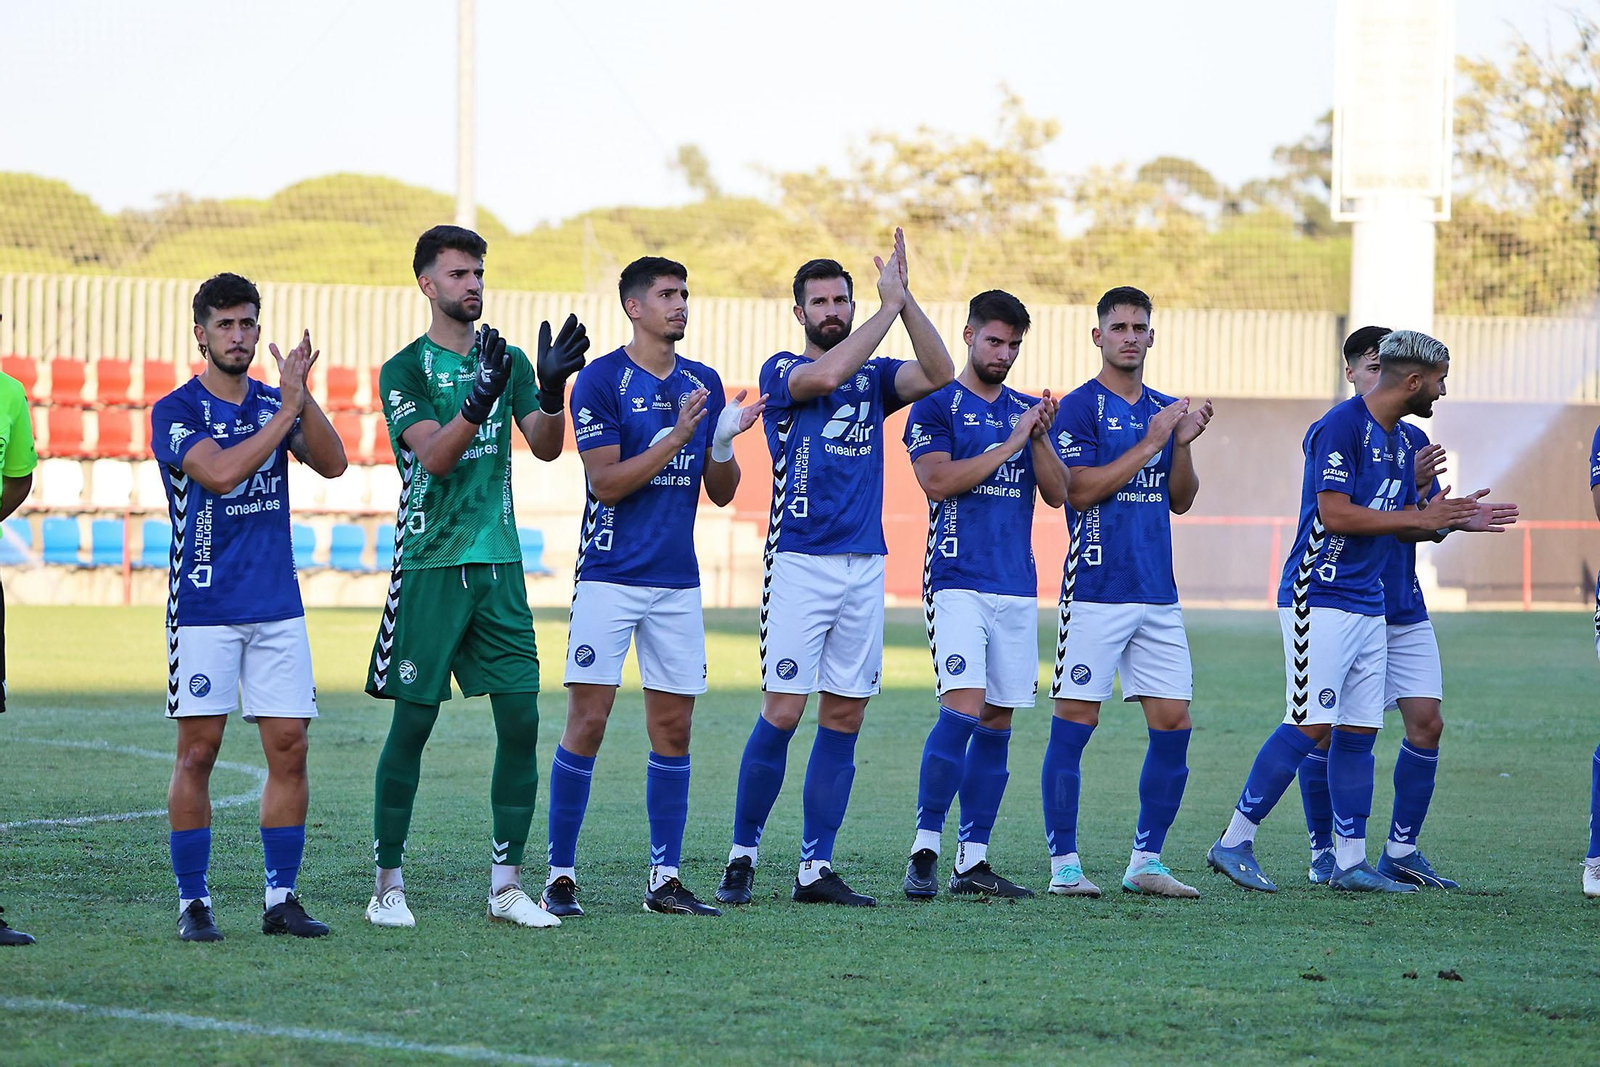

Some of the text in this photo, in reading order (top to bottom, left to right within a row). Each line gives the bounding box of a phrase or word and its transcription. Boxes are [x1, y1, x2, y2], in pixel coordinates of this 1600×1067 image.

[576, 423, 603, 436] SUZUKI
[844, 422, 874, 442] Air
[460, 444, 498, 460] eair.es
[825, 443, 872, 457] oneair.es
[1059, 446, 1082, 454] ZUKI
[794, 447, 803, 493] LA TIENDA
[800, 436, 810, 493] INTELIGENTE
[994, 462, 1026, 483] Air
[1323, 468, 1349, 478] SUZUKI
[248, 471, 282, 497] Air
[651, 473, 691, 486] eair.es
[1136, 468, 1166, 488] Air
[971, 484, 1021, 498] oneair.es
[1116, 491, 1163, 503] oneair.es
[225, 499, 281, 516] oneai.es
[412, 497, 421, 509] LA
[943, 499, 951, 534] LA TIEN
[950, 495, 958, 534] INTELIGE
[1092, 503, 1100, 542] INTELIGE
[194, 510, 205, 562] LA TIENDA
[202, 499, 213, 562] INTELIGENTE
[1086, 530, 1092, 542] LA
